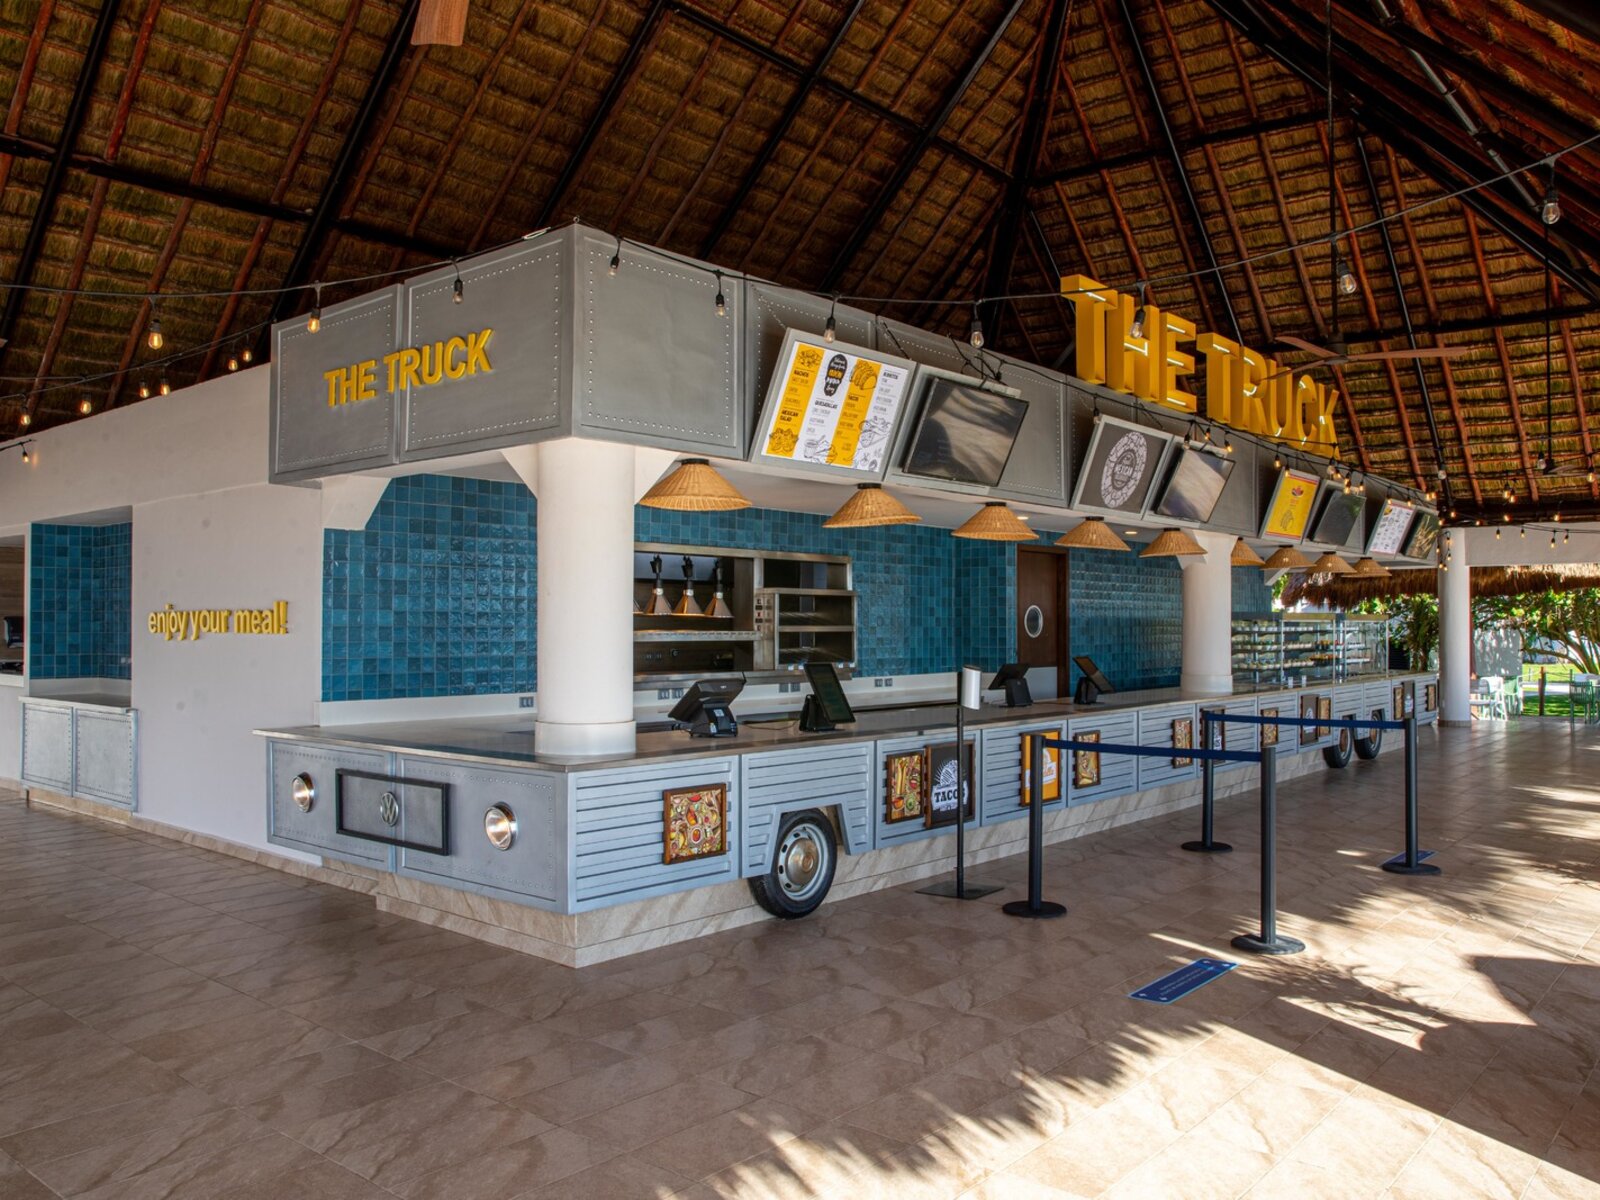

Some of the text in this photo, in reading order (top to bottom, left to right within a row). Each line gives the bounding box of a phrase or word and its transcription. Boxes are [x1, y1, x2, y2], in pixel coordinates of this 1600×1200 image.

[324, 328, 495, 408] THE TRUCK
[1060, 274, 1339, 459] THE TRUCK
[148, 600, 289, 641] enjoy your meal!
